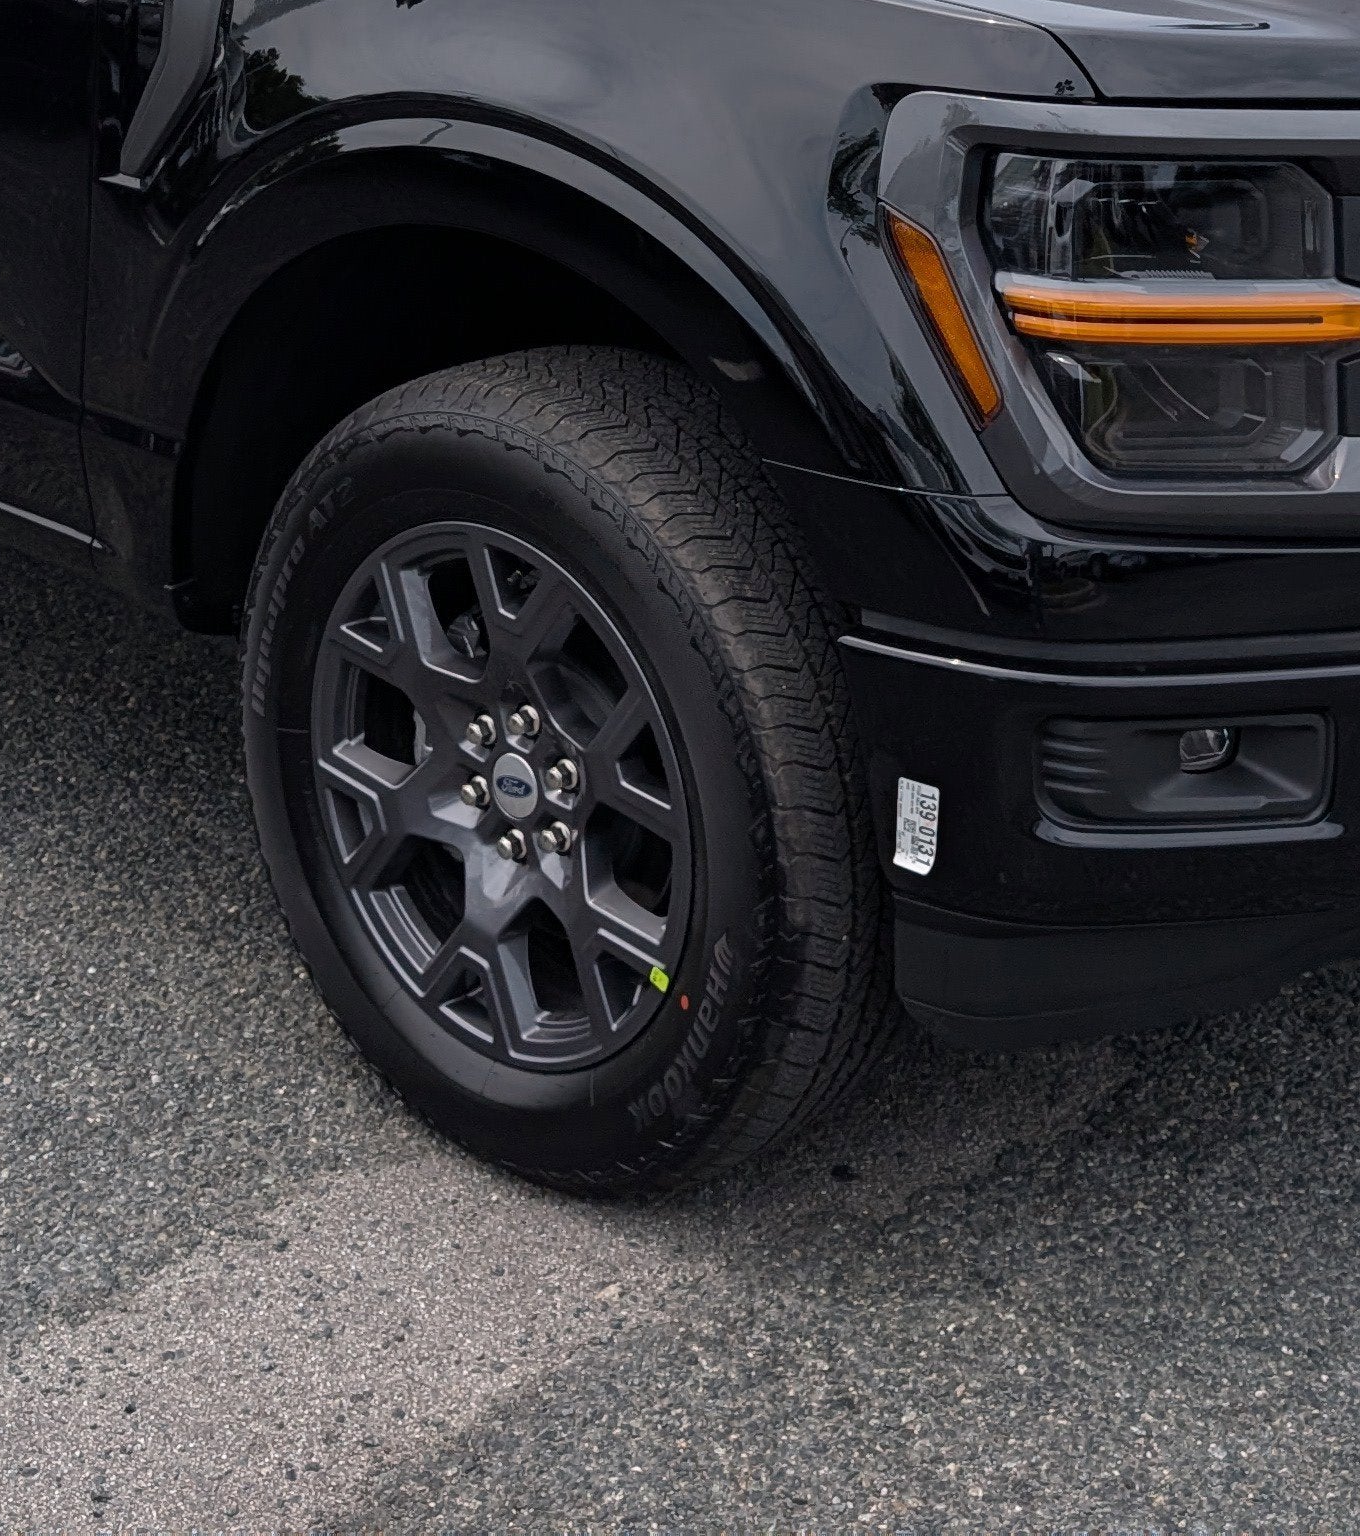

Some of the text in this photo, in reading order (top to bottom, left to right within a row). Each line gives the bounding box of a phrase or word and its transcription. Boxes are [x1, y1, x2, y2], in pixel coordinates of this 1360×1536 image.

[500, 775, 527, 797] Ford
[915, 792, 937, 867] 139 0131
